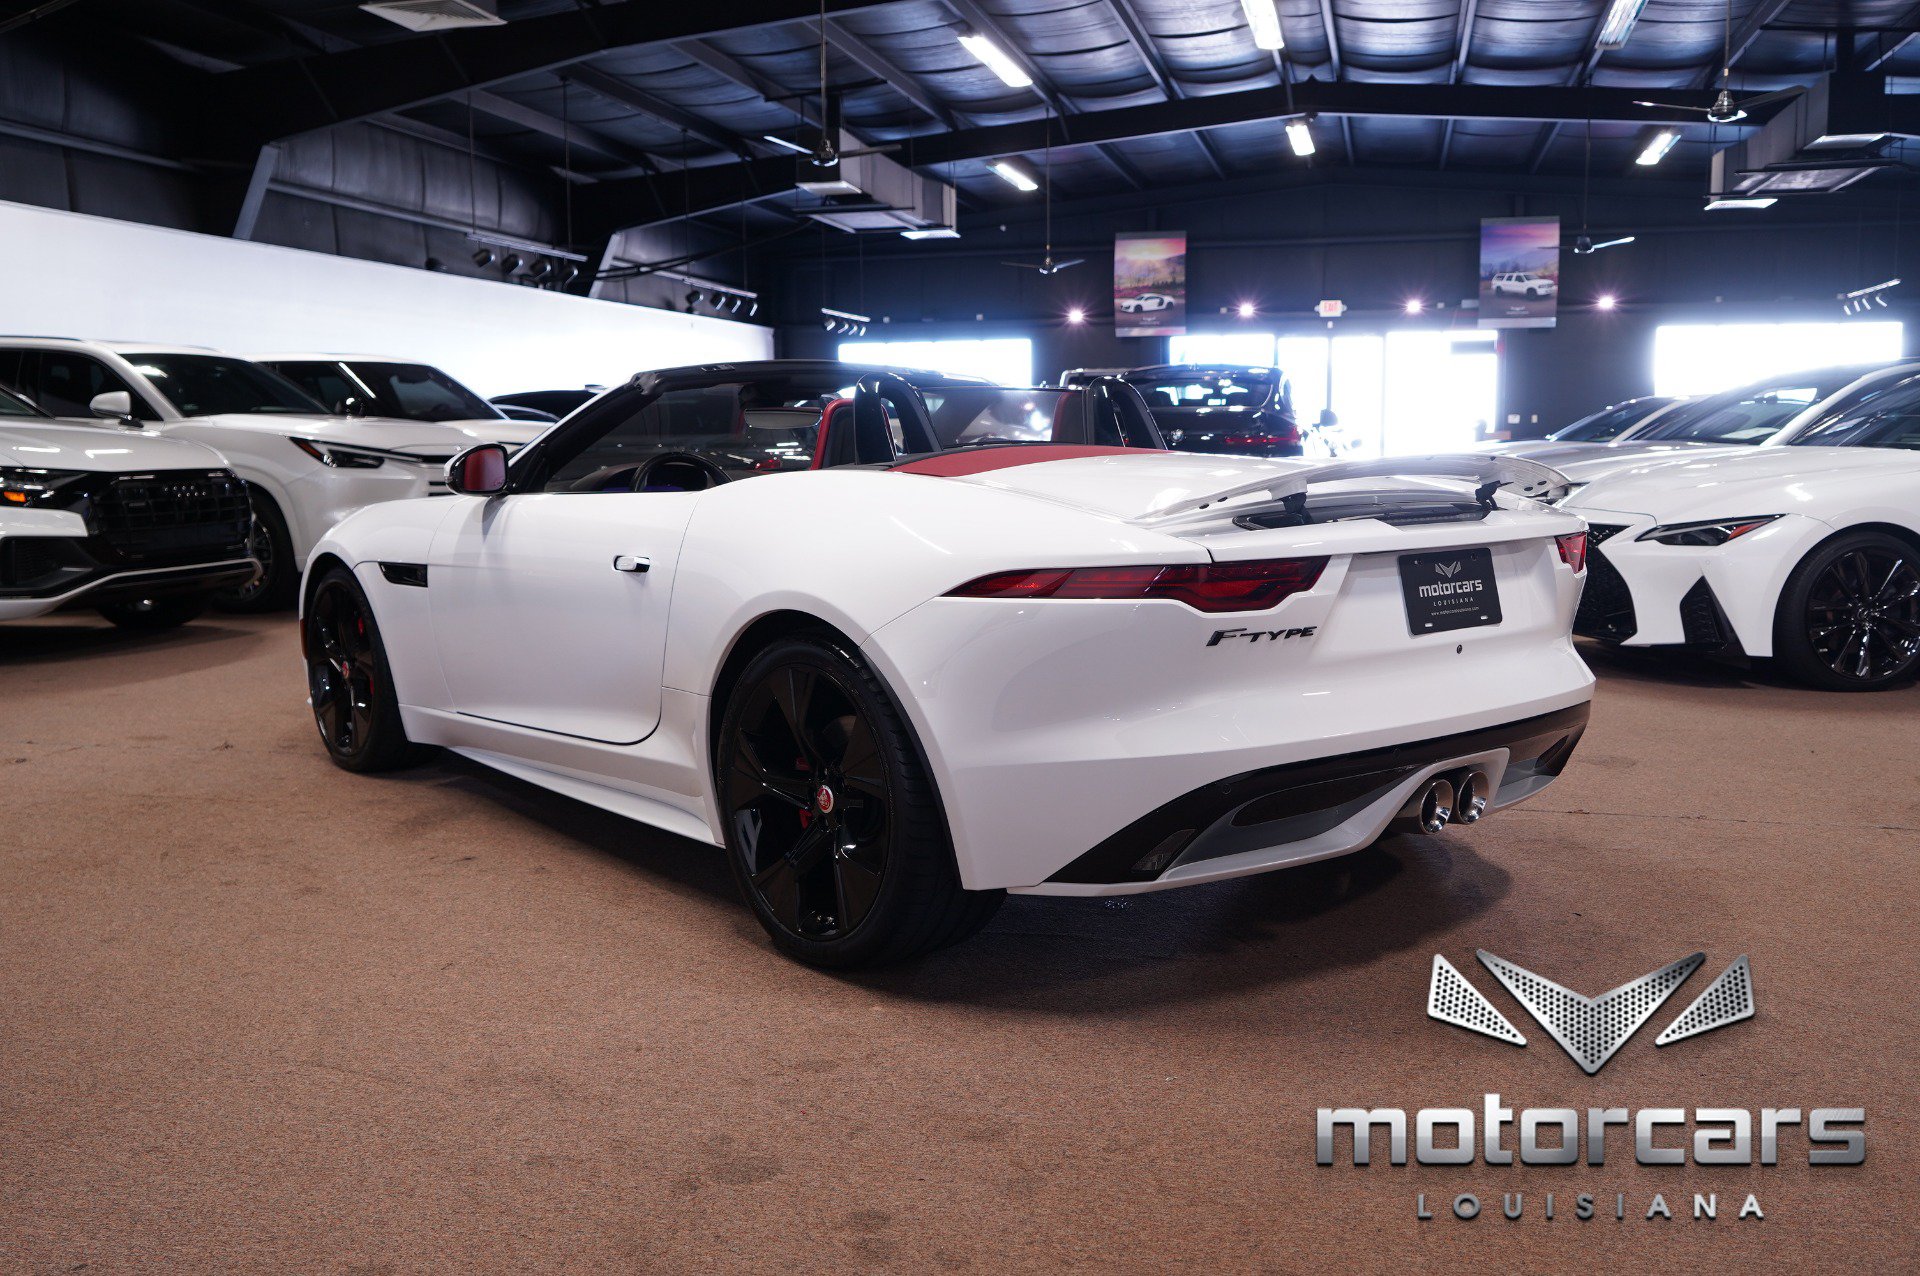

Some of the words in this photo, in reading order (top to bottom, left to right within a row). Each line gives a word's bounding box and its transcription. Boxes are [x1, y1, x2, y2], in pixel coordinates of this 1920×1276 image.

[1419, 579, 1483, 597] motorcars
[1433, 597, 1474, 606] LOUISIANA
[1206, 626, 1317, 647] F-TYPE
